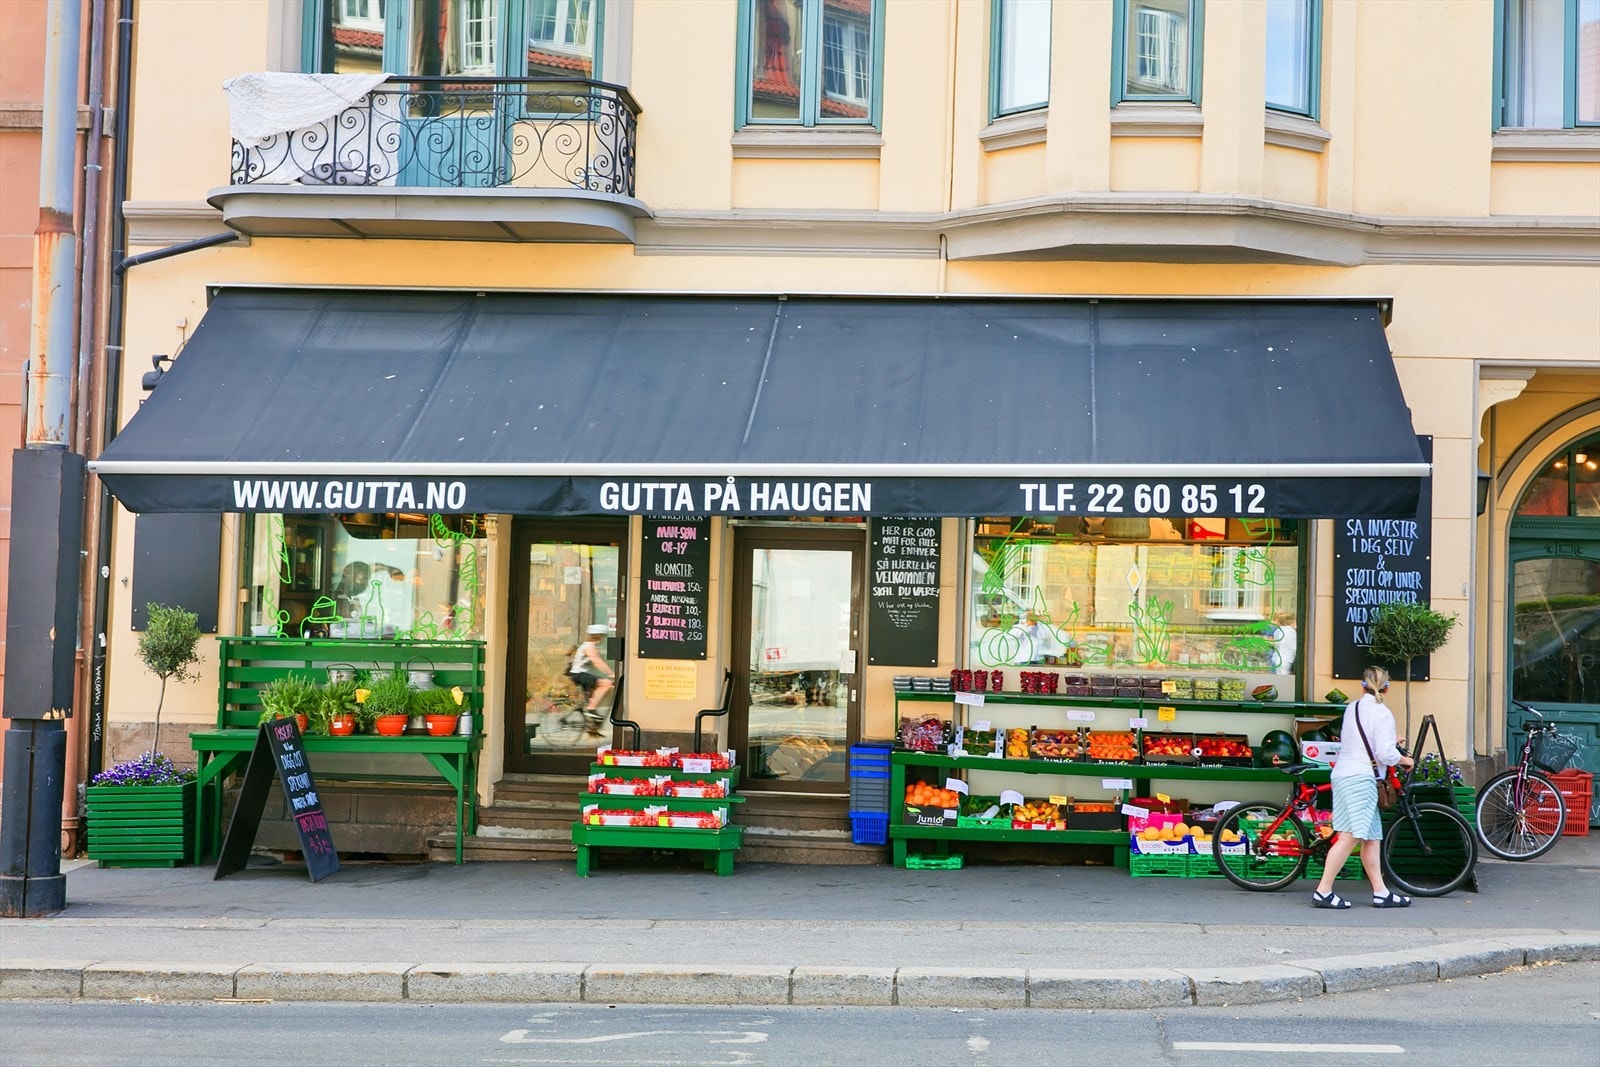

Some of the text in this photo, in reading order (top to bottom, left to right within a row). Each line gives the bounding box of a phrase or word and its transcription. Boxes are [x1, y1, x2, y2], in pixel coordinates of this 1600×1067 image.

[233, 480, 467, 510] WWW.GUTTA.NO
[599, 477, 873, 513] GUTTA PÅ HAUGEN
[1019, 482, 1266, 514] TLF. 22 60 85 12
[882, 526, 936, 537] HER ER GOD
[1368, 518, 1418, 539] INVESTER
[661, 541, 688, 555] 08-19
[882, 537, 900, 545] MAT
[901, 538, 916, 546] FOR
[1352, 538, 1414, 557] I DEG SELV
[883, 546, 896, 554] OG
[876, 558, 889, 570] SÅ
[1376, 554, 1386, 571] &
[875, 570, 936, 585] VELKOMMEN
[1346, 568, 1423, 589] STØTT OPP UNDER
[872, 586, 894, 596] SKAL
[898, 586, 912, 596] DU
[1346, 607, 1367, 624] MED
[645, 627, 651, 638] 3
[916, 814, 945, 824] Junior
